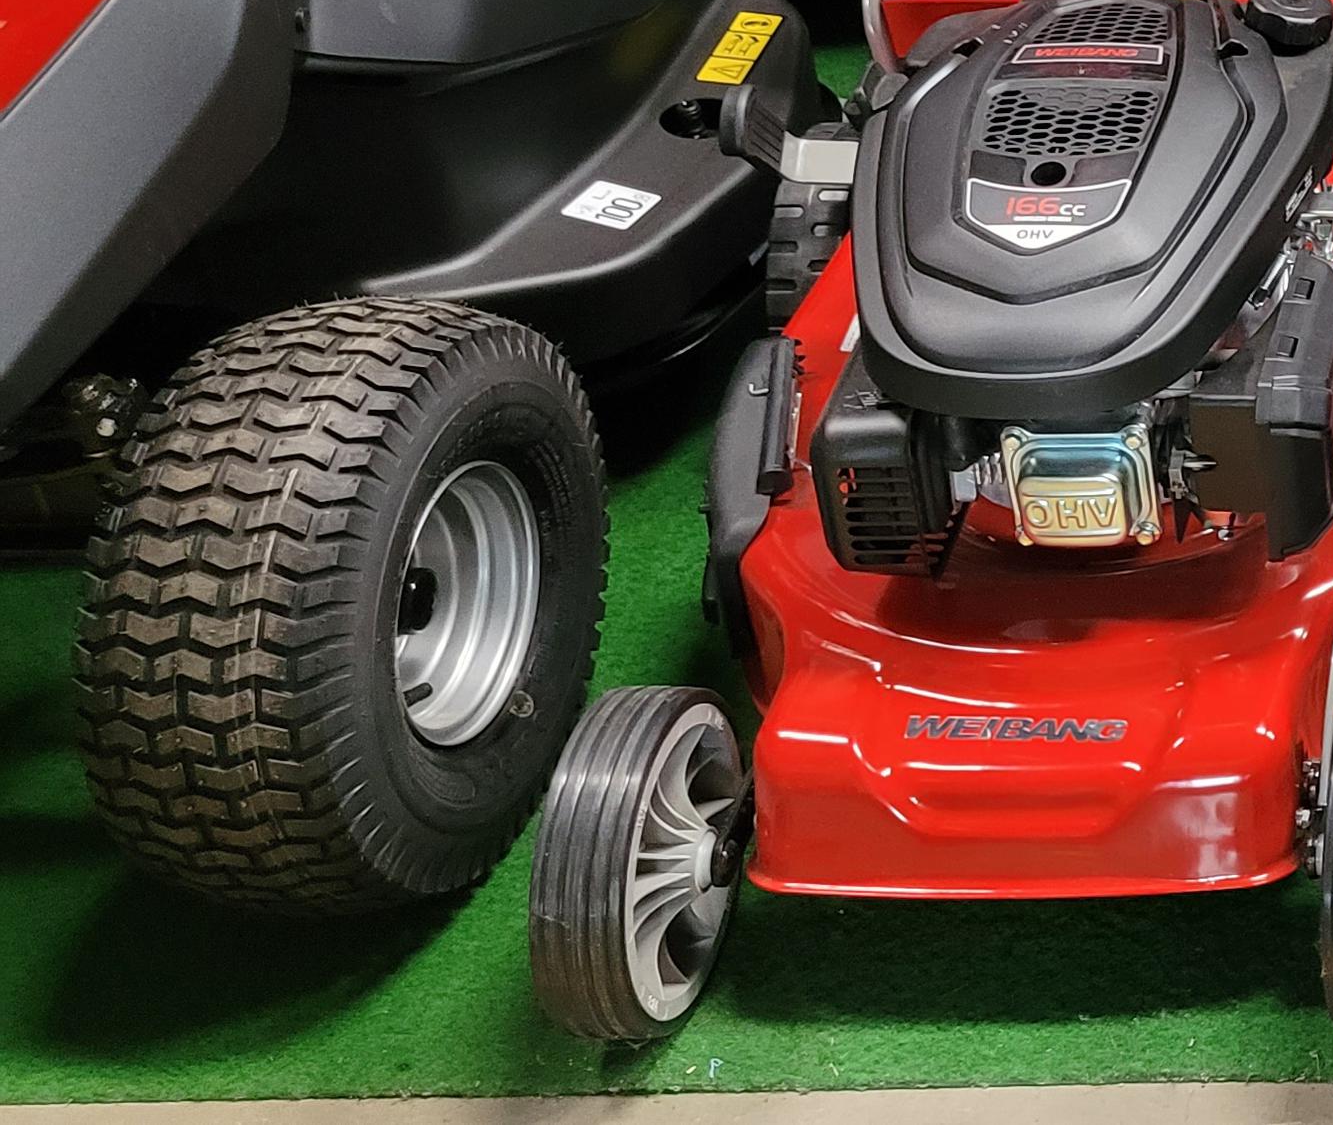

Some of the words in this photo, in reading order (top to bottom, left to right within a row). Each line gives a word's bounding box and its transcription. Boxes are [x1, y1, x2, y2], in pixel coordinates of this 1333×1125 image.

[1034, 47, 1139, 59] WEIBANG
[595, 197, 643, 223] 100
[1006, 195, 1087, 217] 166cc
[1016, 228, 1054, 240] OHV
[1024, 498, 1118, 530] OHV
[904, 715, 1129, 743] WEIBANG
